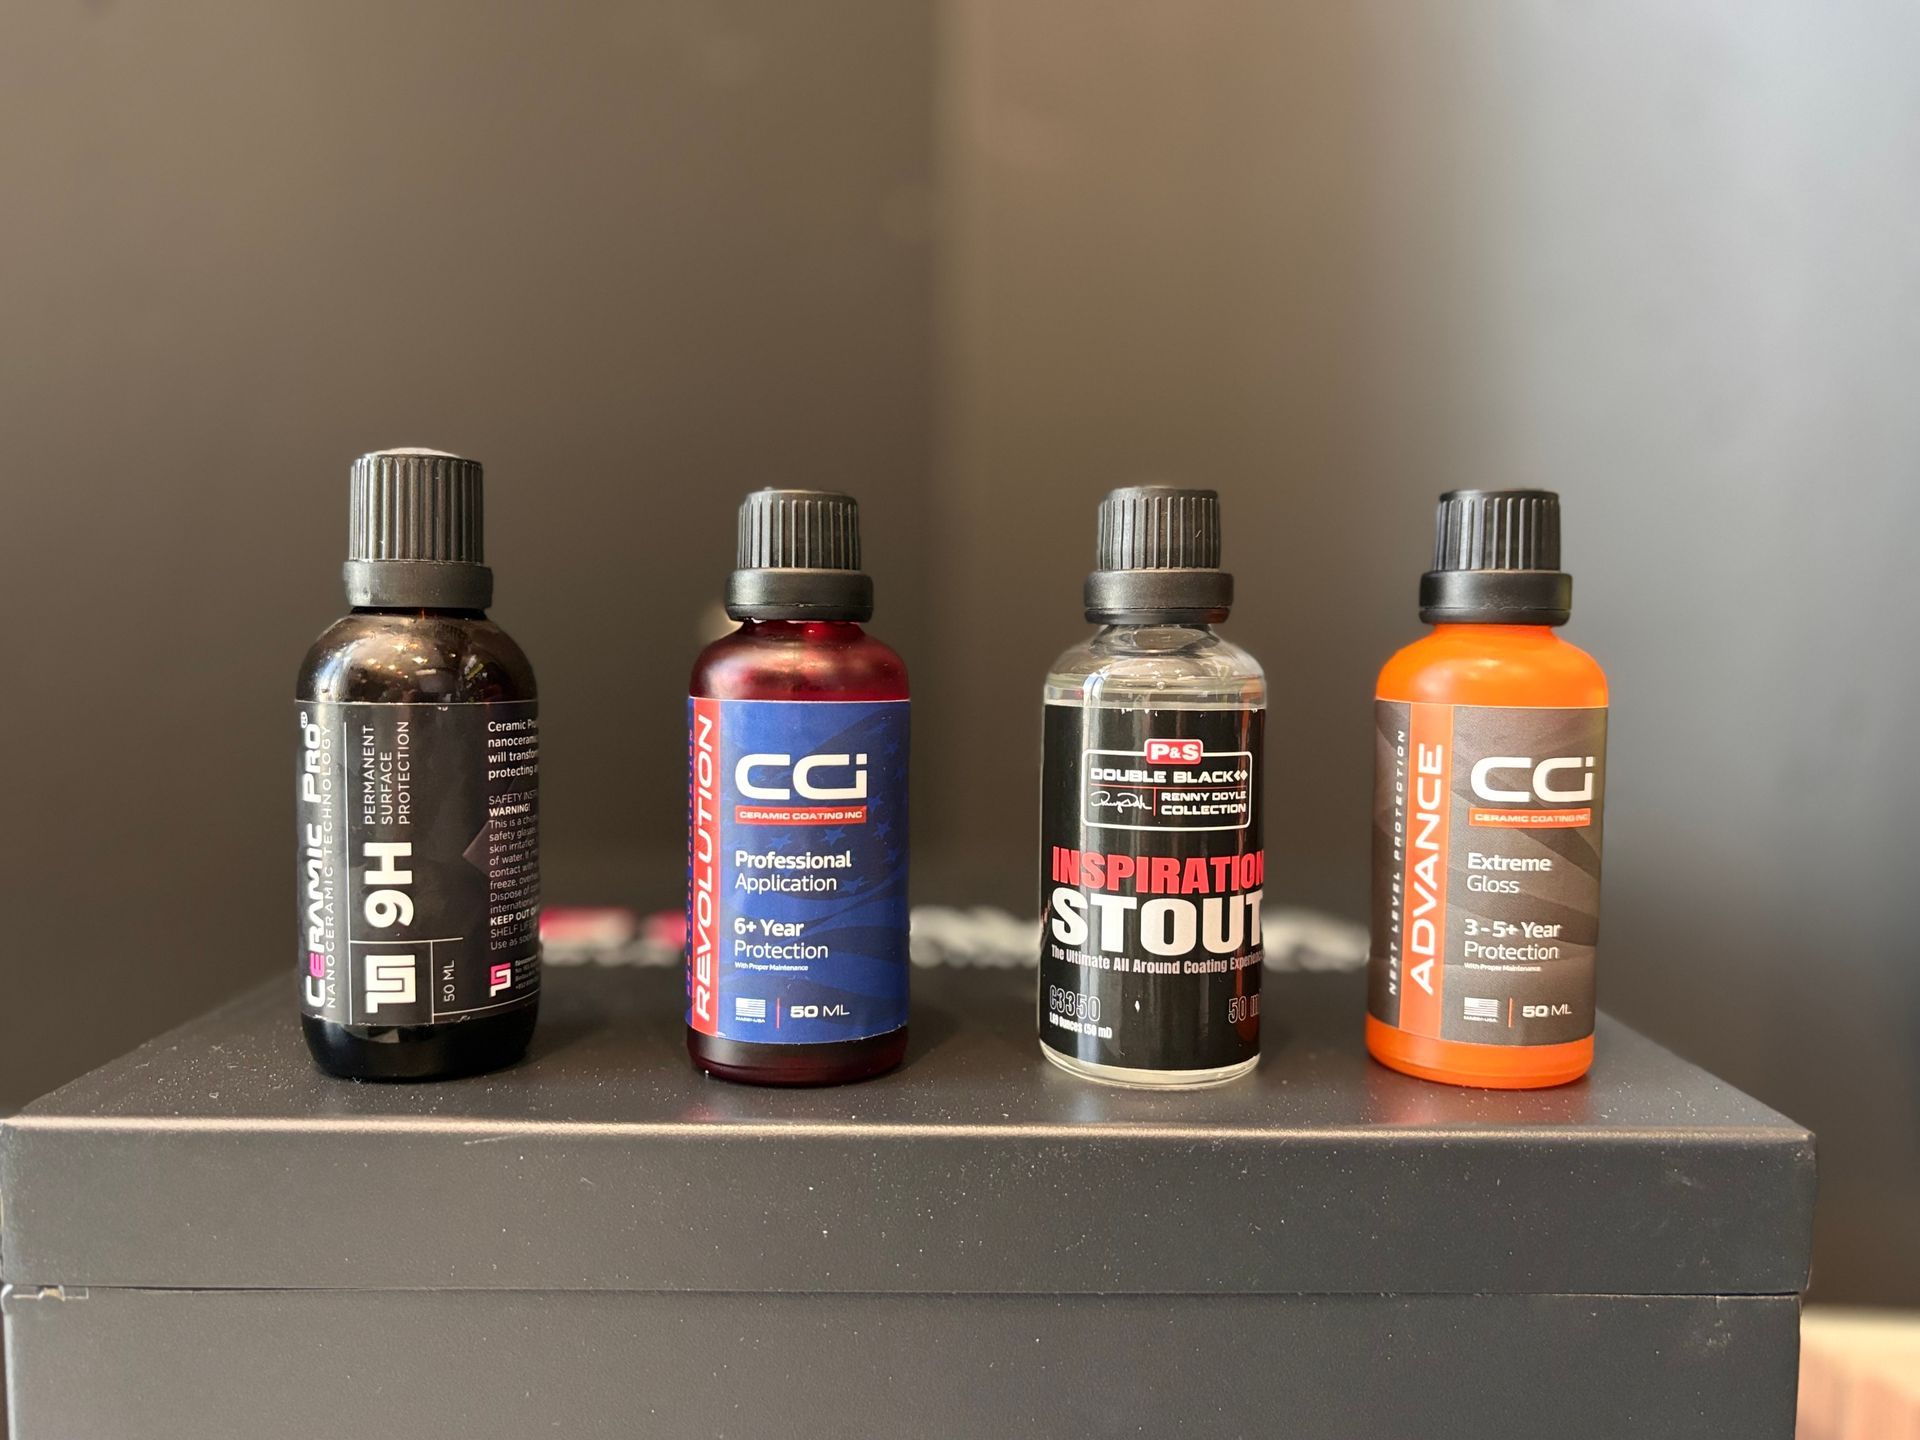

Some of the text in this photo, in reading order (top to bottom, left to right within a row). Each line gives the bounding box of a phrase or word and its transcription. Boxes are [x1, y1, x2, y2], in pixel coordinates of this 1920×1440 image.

[488, 719, 526, 733] Ceramic
[488, 748, 539, 764] will transfor
[1150, 743, 1200, 761] P&S
[362, 724, 376, 826] PERMANENT
[398, 721, 411, 826] PROTECTION
[488, 764, 534, 781] protecting
[1090, 768, 1234, 784] DOUBLE BLACK
[381, 751, 394, 826] SURFACE
[1160, 792, 1210, 802] RENNY
[1211, 790, 1247, 801] DOYLE
[488, 791, 522, 806] SAFETY
[489, 803, 531, 817] WARNING!
[739, 810, 863, 820] CERAMIC COATING INC
[1160, 803, 1247, 816] COLLECTION
[1474, 813, 1529, 823] CERAMIC
[1530, 814, 1575, 823] COATING
[489, 819, 508, 830] This
[509, 818, 516, 827] is
[489, 830, 516, 843] safety
[489, 843, 508, 855] skin
[321, 725, 336, 1009] NANOCERAMIC TECHNOLOGY
[489, 855, 500, 866] of
[694, 715, 714, 1022] REVOLUTION
[735, 849, 852, 870] Professional
[1387, 730, 1406, 995] NEXT LEVEL PROTECTION
[1467, 852, 1552, 872] Extreme
[489, 865, 521, 878] contact
[1052, 845, 1265, 895] INSPIRATION
[1410, 743, 1444, 996] ADVANCE
[364, 841, 415, 929] 9H
[735, 872, 838, 894] Application
[1466, 874, 1520, 894] Gloss
[490, 888, 521, 903] Dispose
[490, 914, 515, 927] KEEP
[515, 909, 530, 921] OUT
[1051, 887, 1265, 957] STOUT
[490, 926, 519, 939] SHELF
[734, 917, 804, 938] 6+ Year
[1520, 920, 1562, 939] Year
[490, 939, 508, 951] Use
[735, 939, 829, 960] Protection
[1464, 940, 1560, 961] Protection
[1051, 943, 1065, 961] The
[1066, 948, 1111, 971] Ultimate
[1113, 953, 1130, 972] All
[1132, 955, 1181, 975] Around
[1183, 957, 1228, 975] Coating
[443, 960, 456, 1003] 50 ML
[790, 1004, 851, 1018] 50 ML
[1227, 995, 1246, 1024] 50
[1522, 1003, 1573, 1018] 50 ML
